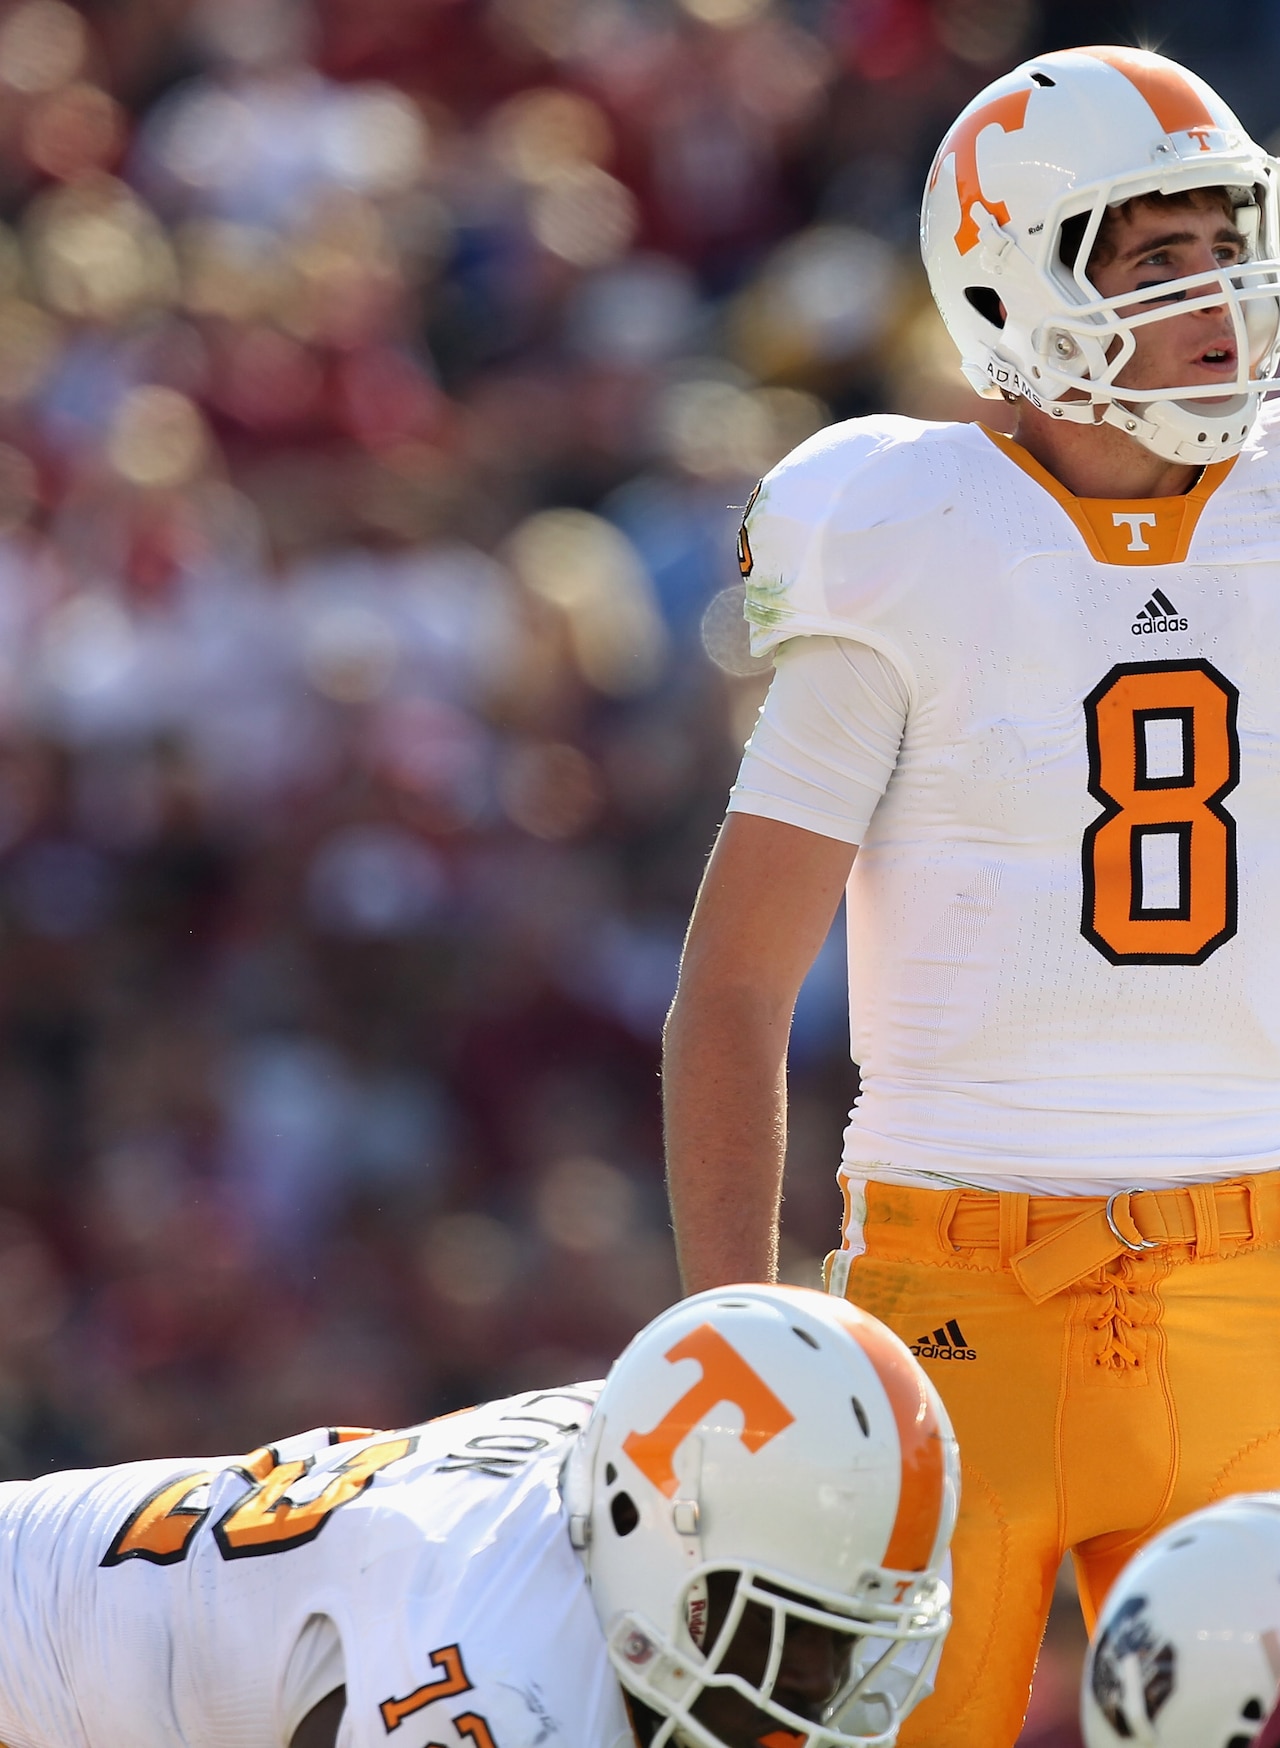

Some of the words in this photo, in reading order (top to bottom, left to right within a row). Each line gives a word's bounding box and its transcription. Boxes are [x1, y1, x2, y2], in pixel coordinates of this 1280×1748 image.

[1187, 131, 1211, 151] T
[929, 88, 1033, 257] T
[1028, 222, 1044, 236] Ridd
[986, 362, 1043, 409] ADAMS
[1112, 512, 1157, 552] T
[1131, 615, 1189, 636] adidas
[1080, 657, 1241, 967] 8
[909, 1344, 977, 1361] adidas
[621, 1320, 797, 1500] T
[434, 1392, 598, 1478] LTON
[894, 1580, 916, 1604] T
[689, 1599, 706, 1641] Ridd
